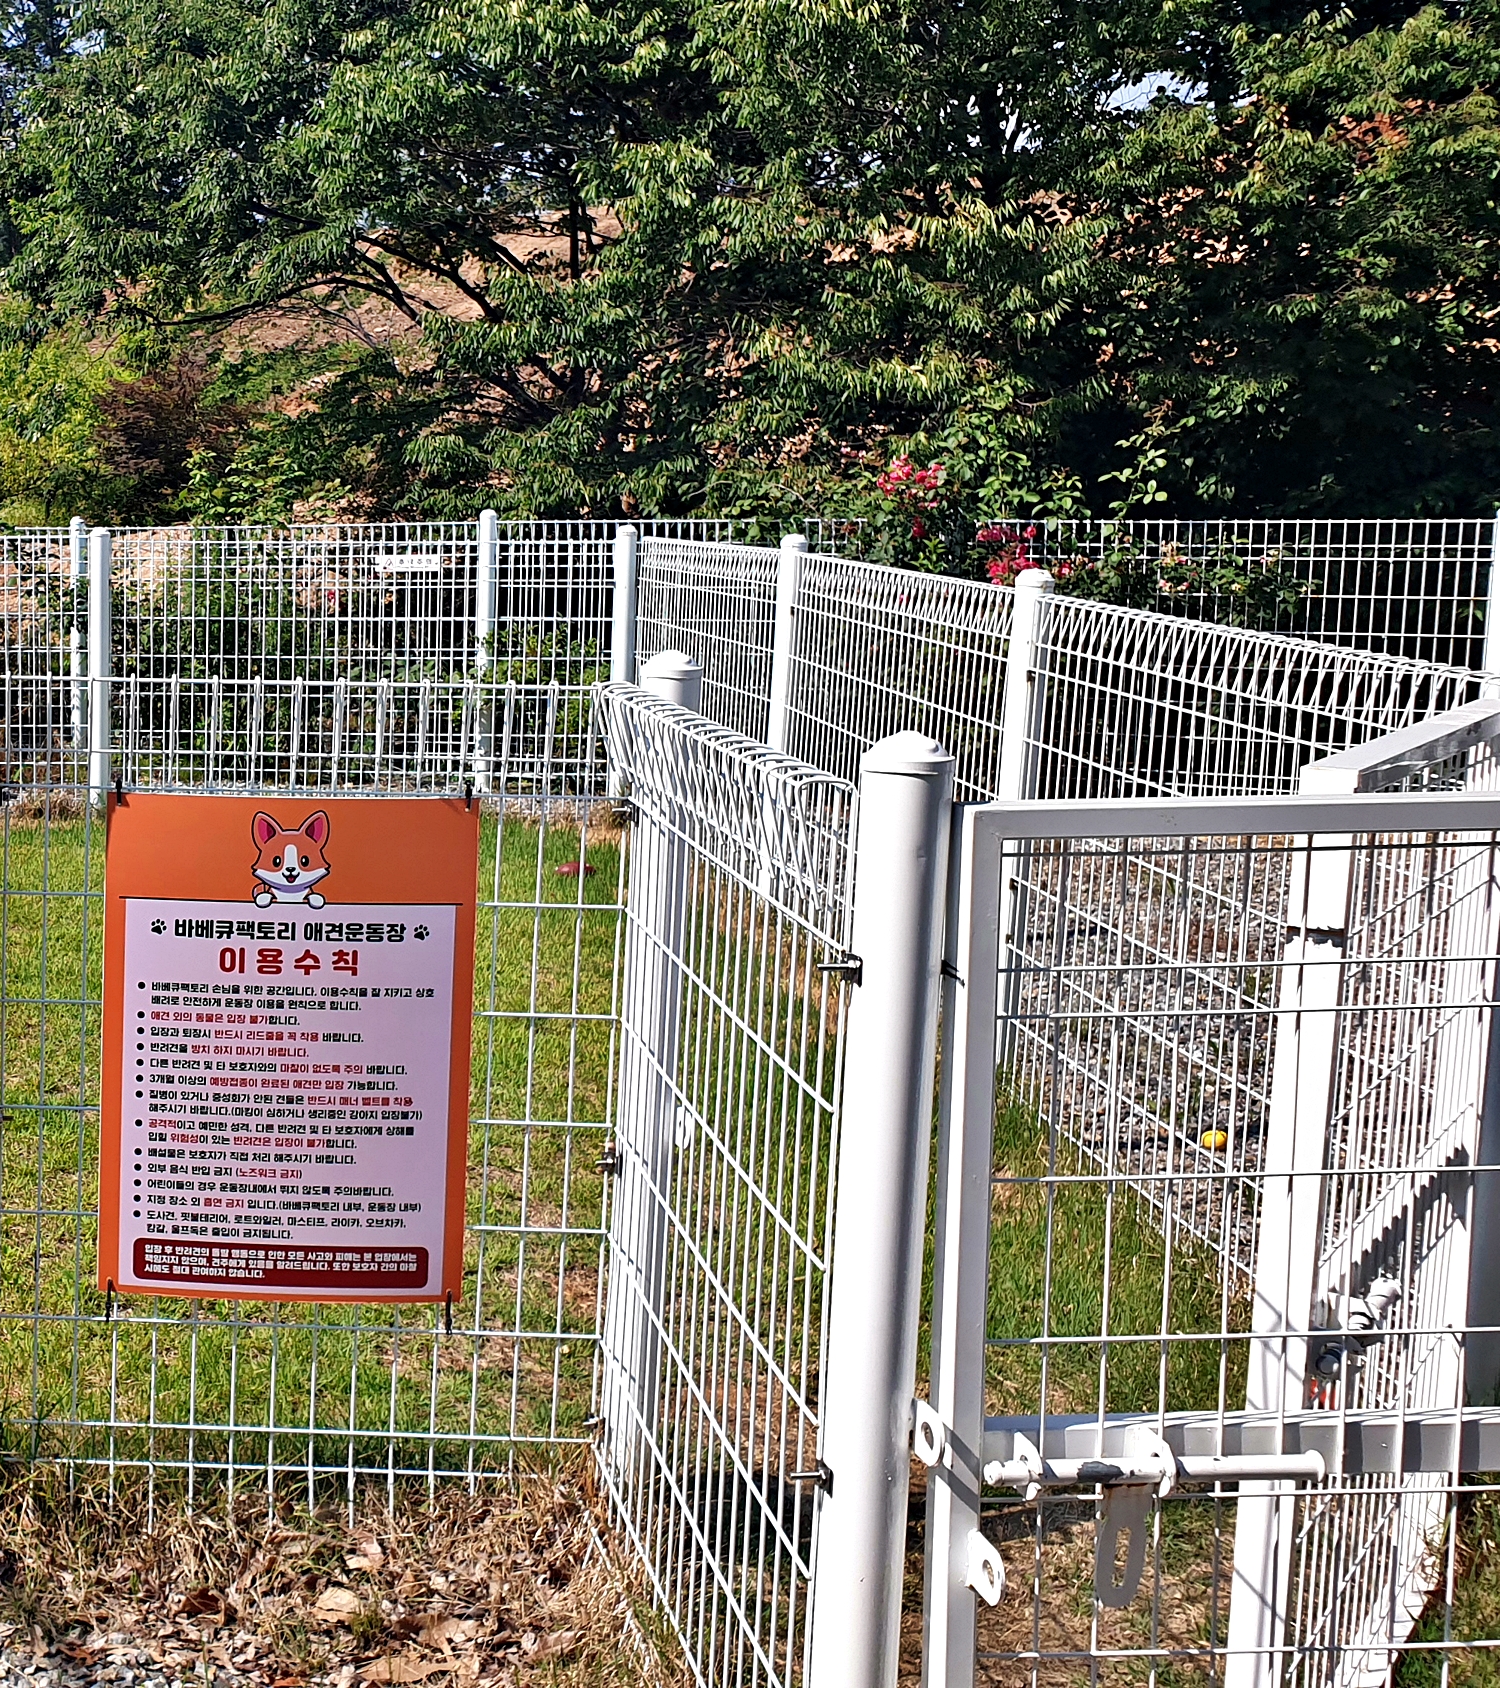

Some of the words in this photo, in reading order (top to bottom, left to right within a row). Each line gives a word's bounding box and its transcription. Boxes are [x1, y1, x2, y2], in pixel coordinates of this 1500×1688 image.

[174, 920, 296, 940] 바베큐팩토리
[304, 922, 406, 942] 애견운동장
[152, 982, 208, 993] 바베큐팩토리
[212, 984, 240, 994] 손님을
[244, 985, 263, 995] 위한
[266, 986, 316, 996] 공간입니다.
[321, 987, 367, 997] 이용수칙을
[371, 988, 380, 997] 잘
[384, 988, 412, 997] 지키고
[416, 988, 434, 998] 상호
[152, 996, 179, 1005] 배려로
[183, 997, 221, 1007] 안전하게
[225, 999, 252, 1008] 운동장
[256, 999, 284, 1009] 이용을
[288, 1001, 326, 1009] 원칙으로
[330, 1001, 361, 1010] 합니다.
[151, 1011, 169, 1020] 애견
[173, 1012, 192, 1021] 외의
[196, 1013, 223, 1022] 동물은
[227, 1015, 245, 1023] 입장
[250, 1015, 300, 1025] 불가합니다.
[151, 1027, 179, 1037] 입장과
[182, 1028, 211, 1038] 퇴장시
[215, 1030, 242, 1039] 반드시
[246, 1031, 284, 1040] 리드줄을
[288, 1032, 296, 1041] 꼭
[300, 1032, 318, 1041] 착용
[322, 1033, 364, 1042] 바랍니다.
[151, 1043, 188, 1053] 반려견을
[191, 1045, 210, 1054] 방치
[214, 1046, 232, 1055] 하지
[236, 1046, 264, 1056] 마시기
[268, 1047, 309, 1057] 바랍니다.
[150, 1059, 168, 1068] 다른
[172, 1060, 200, 1069] 반려견
[204, 1061, 212, 1070] 및
[216, 1062, 225, 1070] 타
[229, 1062, 276, 1072] 보호자와의
[281, 1064, 309, 1073] 마찰이
[312, 1065, 340, 1074] 없도록
[344, 1065, 362, 1074] 주의
[366, 1066, 407, 1075] 바랍니다.
[150, 1074, 174, 1084] 3개월
[178, 1076, 206, 1085] 이상의
[210, 1078, 257, 1087] 예방접종이
[261, 1079, 289, 1088] 완료된
[293, 1080, 321, 1089] 애견만
[325, 1081, 344, 1089] 입장
[348, 1081, 398, 1090] 가능합니다.
[149, 1090, 177, 1099] 질병이
[181, 1092, 209, 1101] 있거나
[212, 1093, 250, 1103] 중성화가
[254, 1095, 272, 1104] 안된
[276, 1095, 304, 1105] 견들은
[308, 1096, 335, 1105] 반드시
[340, 1097, 358, 1105] 매너
[362, 1097, 390, 1106] 벨트를
[394, 1097, 413, 1106] 착용
[149, 1104, 186, 1114] 해주시기
[266, 1108, 304, 1118] 심하거나
[308, 1110, 346, 1119] 생리중인
[349, 1111, 377, 1119] 강아지
[381, 1110, 422, 1120] 입장불가)
[148, 1119, 195, 1130] 공격적이고
[199, 1121, 227, 1131] 예민한
[256, 1124, 274, 1133] 다른
[278, 1124, 306, 1134] 반려견
[310, 1125, 318, 1134] 및
[322, 1126, 331, 1134] 타
[335, 1126, 382, 1135] 보호자에게
[386, 1127, 414, 1135] 상해를
[148, 1132, 167, 1142] 입힐
[170, 1133, 208, 1144] 위험성이
[212, 1135, 230, 1145] 있는
[234, 1136, 271, 1146] 반려견은
[275, 1138, 303, 1147] 입장이
[307, 1138, 357, 1148] 불가합니다.
[148, 1148, 185, 1158] 배설물은
[189, 1150, 226, 1160] 보호자가
[230, 1152, 248, 1161] 직접
[252, 1152, 270, 1162] 처리
[274, 1153, 311, 1163] 해주시기
[315, 1154, 356, 1164] 바랍니다.
[148, 1164, 166, 1173] 외부
[170, 1165, 188, 1174] 음식
[192, 1167, 210, 1175] 반입
[214, 1168, 232, 1176] 금지
[236, 1168, 276, 1178] (노즈워크
[280, 1169, 302, 1179] 금지)
[148, 1179, 194, 1190] 어린이들의
[198, 1182, 216, 1191] 경우
[220, 1183, 276, 1194] 운동장내에서
[280, 1185, 298, 1195] 뛰지
[302, 1186, 330, 1195] 않도록
[334, 1187, 394, 1196] 주의바랍니다.
[147, 1195, 165, 1204] 지정
[169, 1196, 187, 1206] 장소
[191, 1198, 200, 1206] 외
[204, 1198, 222, 1207] 흡연
[226, 1199, 244, 1208] 금지
[368, 1203, 395, 1212] 운동장
[399, 1203, 421, 1212] 내부)
